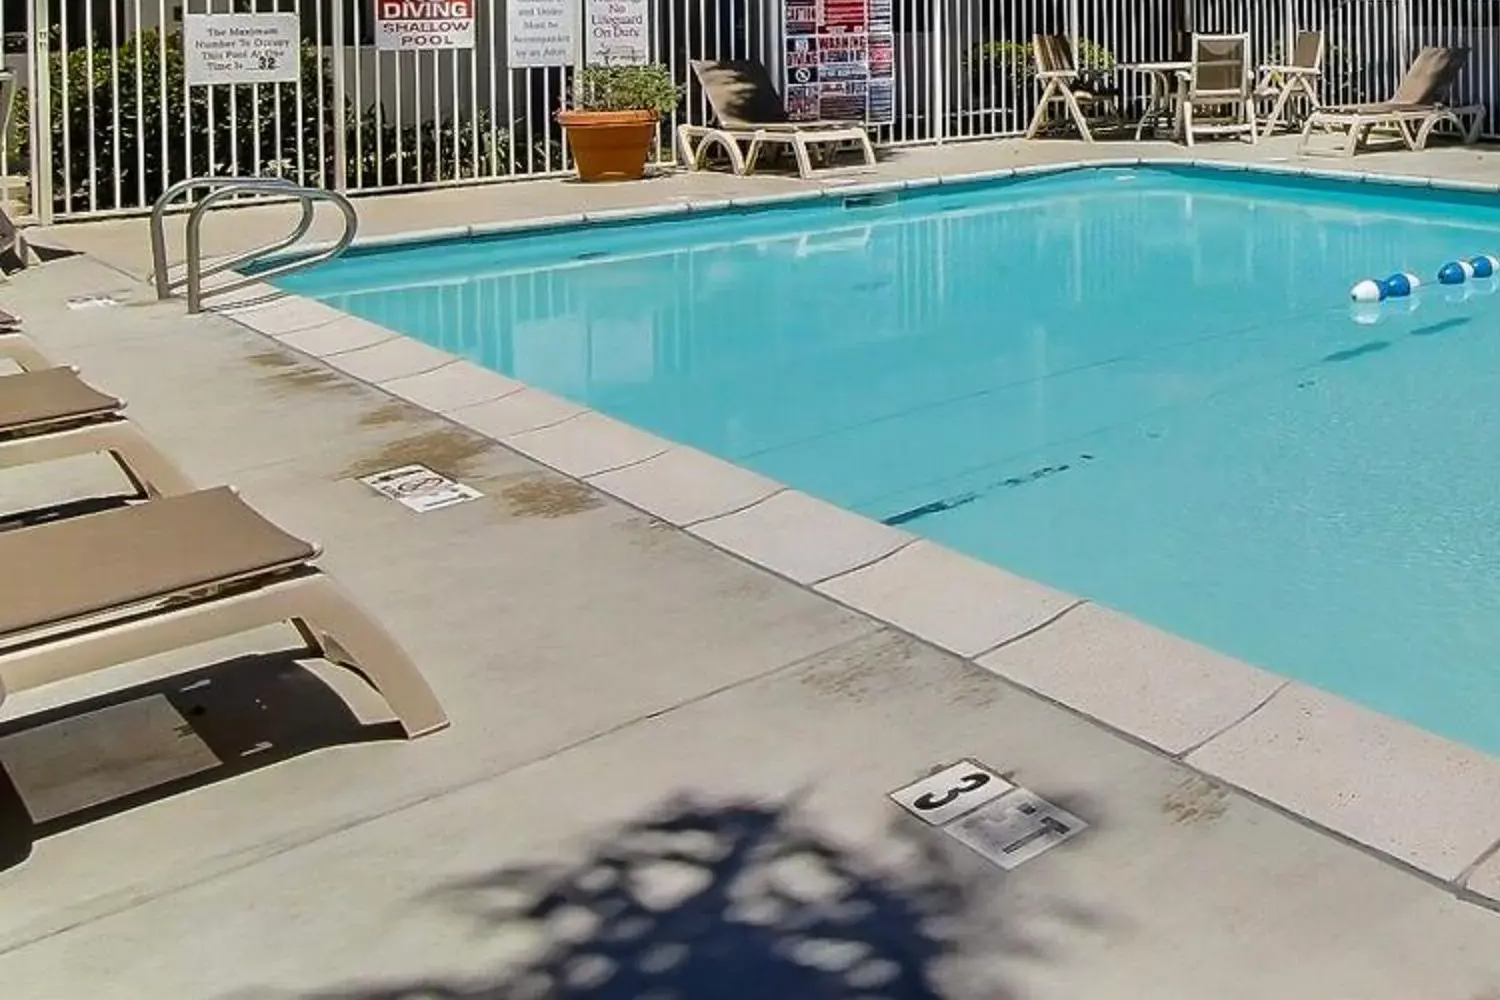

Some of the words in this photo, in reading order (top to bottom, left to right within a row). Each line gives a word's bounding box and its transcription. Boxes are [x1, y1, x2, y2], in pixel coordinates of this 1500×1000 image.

[383, 2, 468, 18] DIVING
[609, 4, 627, 13] No
[592, 14, 643, 26] Lifeguard
[207, 28, 226, 36] The
[229, 27, 278, 36] Maximum
[383, 22, 470, 32] SHALLOW
[593, 27, 611, 38] On
[613, 26, 640, 38] Duty
[195, 39, 235, 48] Number
[240, 39, 251, 47] To
[254, 38, 289, 49] Occupy
[401, 35, 454, 46] POOL
[202, 51, 222, 60] This
[225, 51, 247, 59] Pool
[265, 49, 284, 58] One
[207, 62, 232, 71] Time
[259, 56, 276, 70] 32
[914, 773, 990, 810] 3
